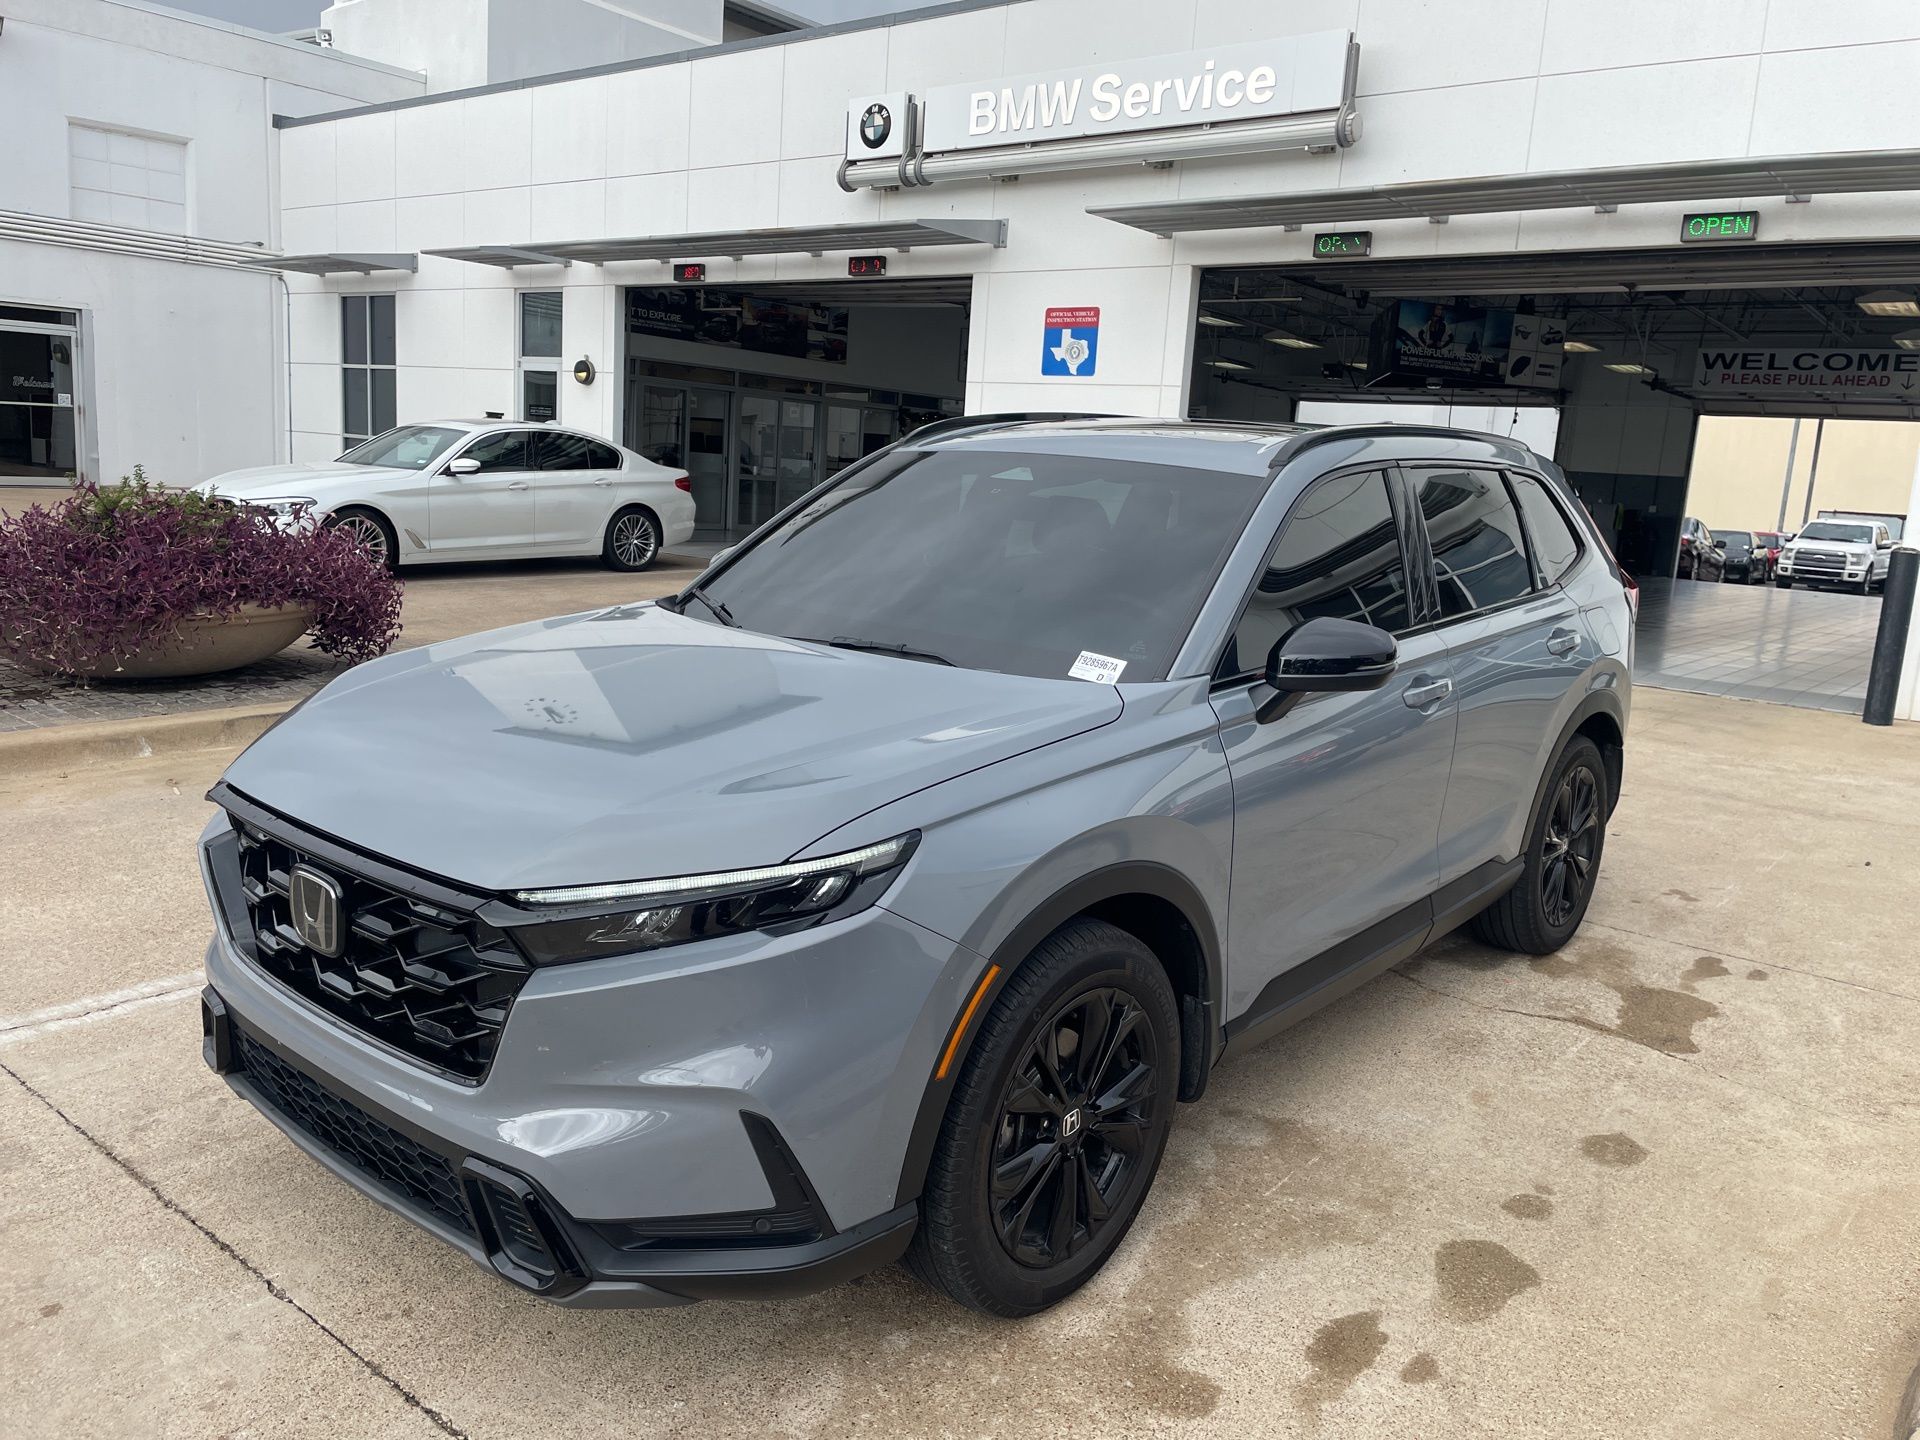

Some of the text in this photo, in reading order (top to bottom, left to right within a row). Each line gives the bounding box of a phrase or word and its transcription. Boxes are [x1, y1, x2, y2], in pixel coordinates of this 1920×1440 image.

[968, 58, 1278, 137] BMW Service
[1689, 215, 1750, 236] OPEN
[637, 308, 648, 317] TO
[1401, 345, 1442, 358] POWERFUL
[1702, 352, 1920, 373] WELCOME
[1721, 373, 1891, 387] PLEASE PULL AHEAD
[1078, 655, 1118, 672] T9285967A
[1096, 673, 1105, 682] D
